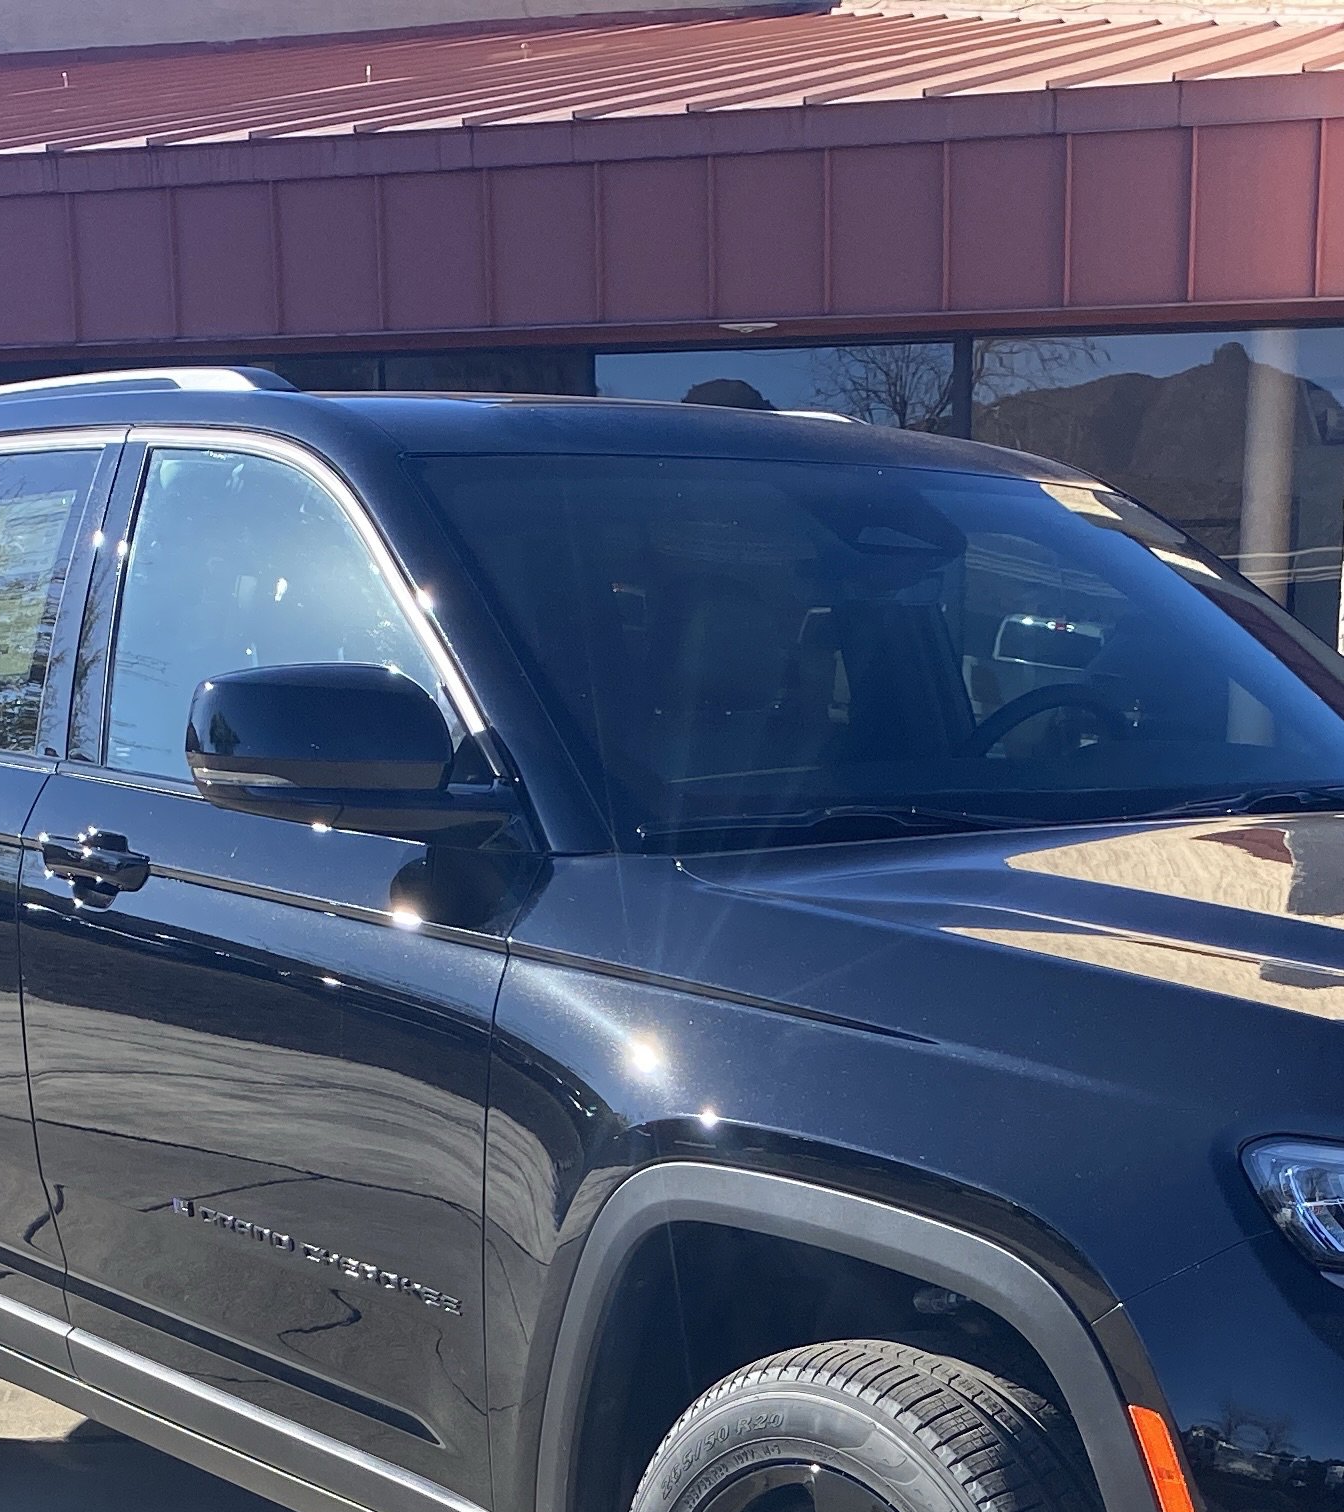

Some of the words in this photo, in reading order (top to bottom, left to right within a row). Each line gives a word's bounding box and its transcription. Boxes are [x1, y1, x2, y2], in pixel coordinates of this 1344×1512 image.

[199, 1205, 295, 1251] GRAND
[301, 1242, 463, 1316] CHEROKEE
[735, 1411, 785, 1436] R20
